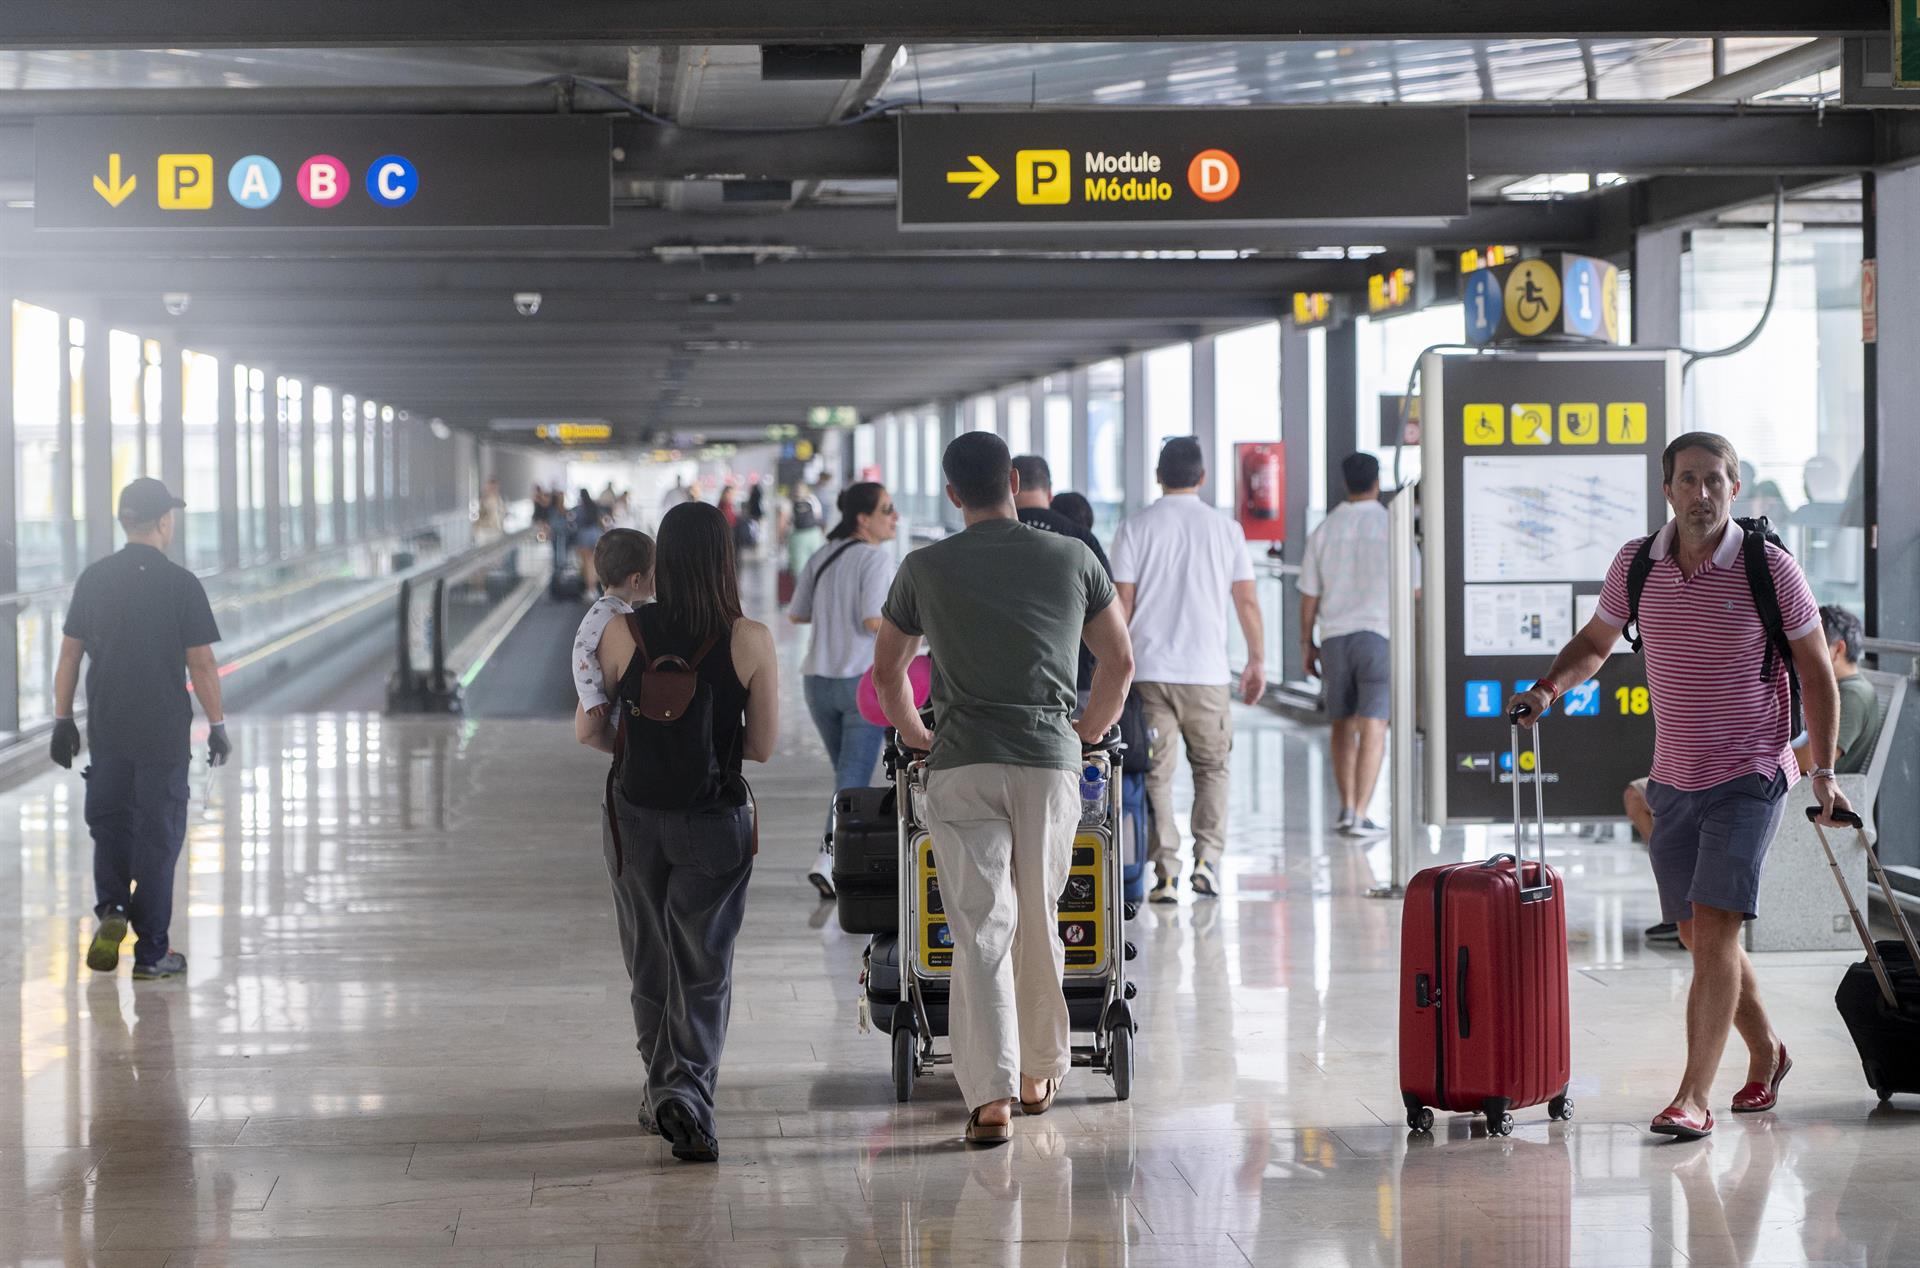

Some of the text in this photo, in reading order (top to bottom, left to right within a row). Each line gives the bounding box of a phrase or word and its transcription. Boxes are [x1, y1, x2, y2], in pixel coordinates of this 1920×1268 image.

[1085, 151, 1161, 174] Module
[1201, 159, 1227, 193] D
[174, 163, 405, 199] P A B C
[1032, 161, 1058, 196] P
[1085, 177, 1173, 202] Módulo
[1615, 686, 1650, 715] 18
